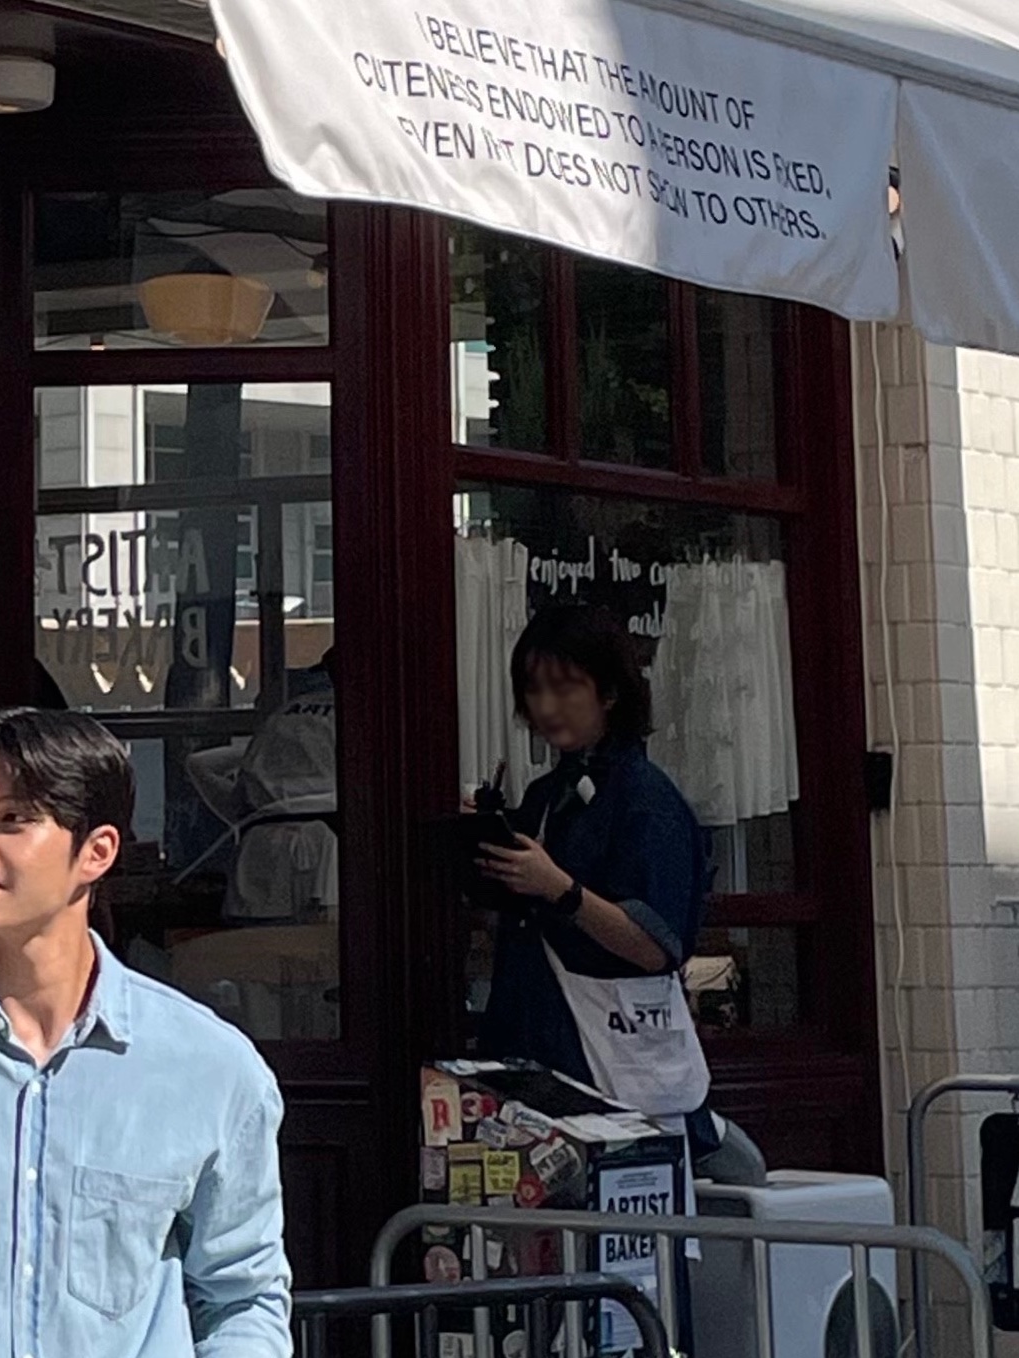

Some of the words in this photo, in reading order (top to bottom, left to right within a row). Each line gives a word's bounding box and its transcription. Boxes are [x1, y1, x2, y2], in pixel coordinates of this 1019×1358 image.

[426, 15, 528, 72] BELIEVE
[523, 42, 591, 85] THAT
[593, 56, 638, 98] THE
[725, 97, 756, 131] OF
[486, 82, 611, 139] ENDOWED
[612, 111, 645, 147] TO
[743, 149, 771, 181] IS
[592, 157, 643, 198] NOT
[690, 190, 728, 225] TO
[530, 535, 596, 596] enjoyed
[608, 547, 642, 584] two
